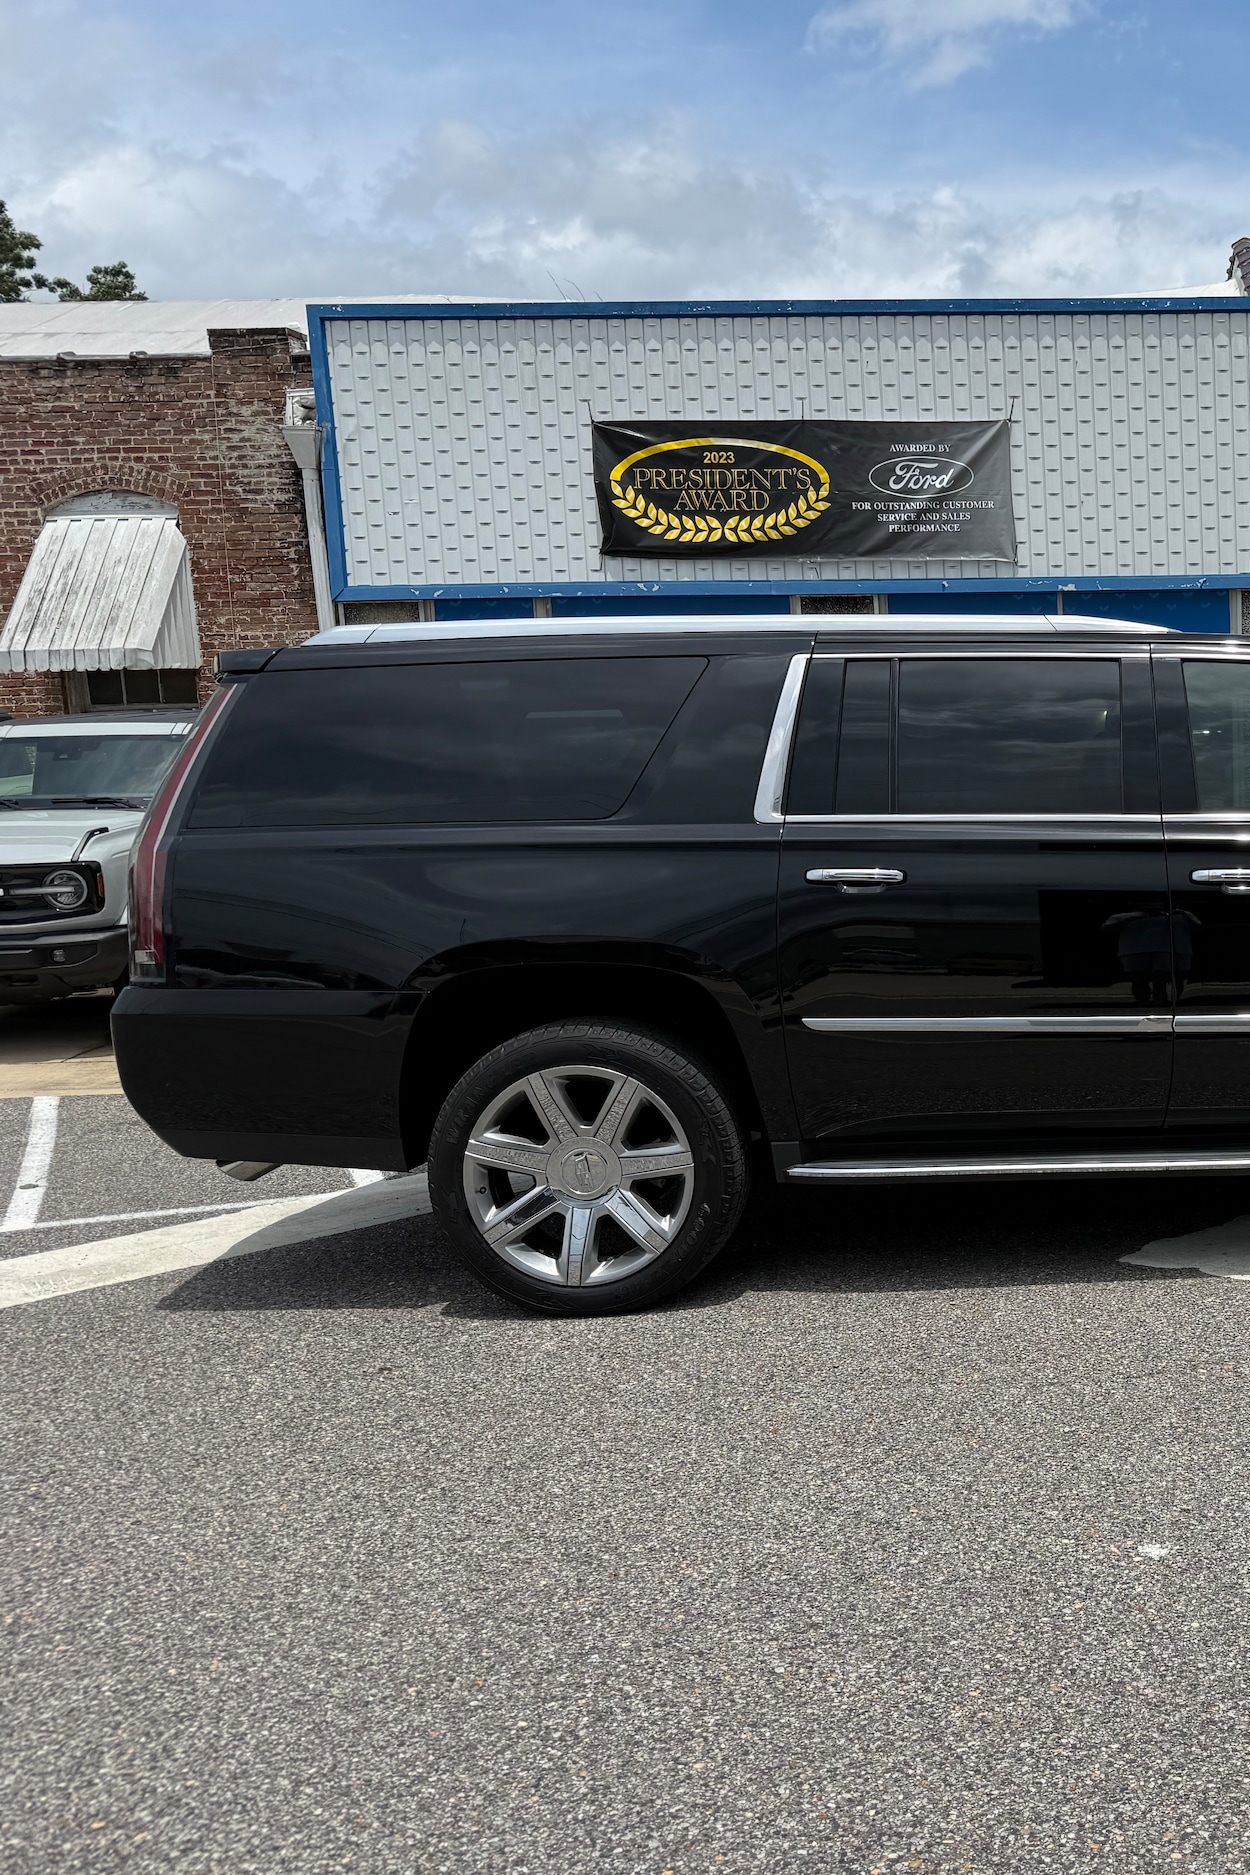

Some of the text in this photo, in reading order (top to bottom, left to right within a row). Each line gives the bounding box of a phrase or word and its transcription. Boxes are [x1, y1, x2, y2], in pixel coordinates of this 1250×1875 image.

[889, 443, 951, 453] AWARDED BY
[703, 451, 736, 464] 2023
[632, 467, 812, 490] PRESIDENT'S
[888, 461, 955, 490] Ford
[672, 489, 770, 512] AWARD
[852, 500, 995, 511] FOR OUTSTANDING CUSTOMER
[877, 512, 971, 522] SERVICE AND SALES
[888, 523, 961, 533] PERFORMANCE
